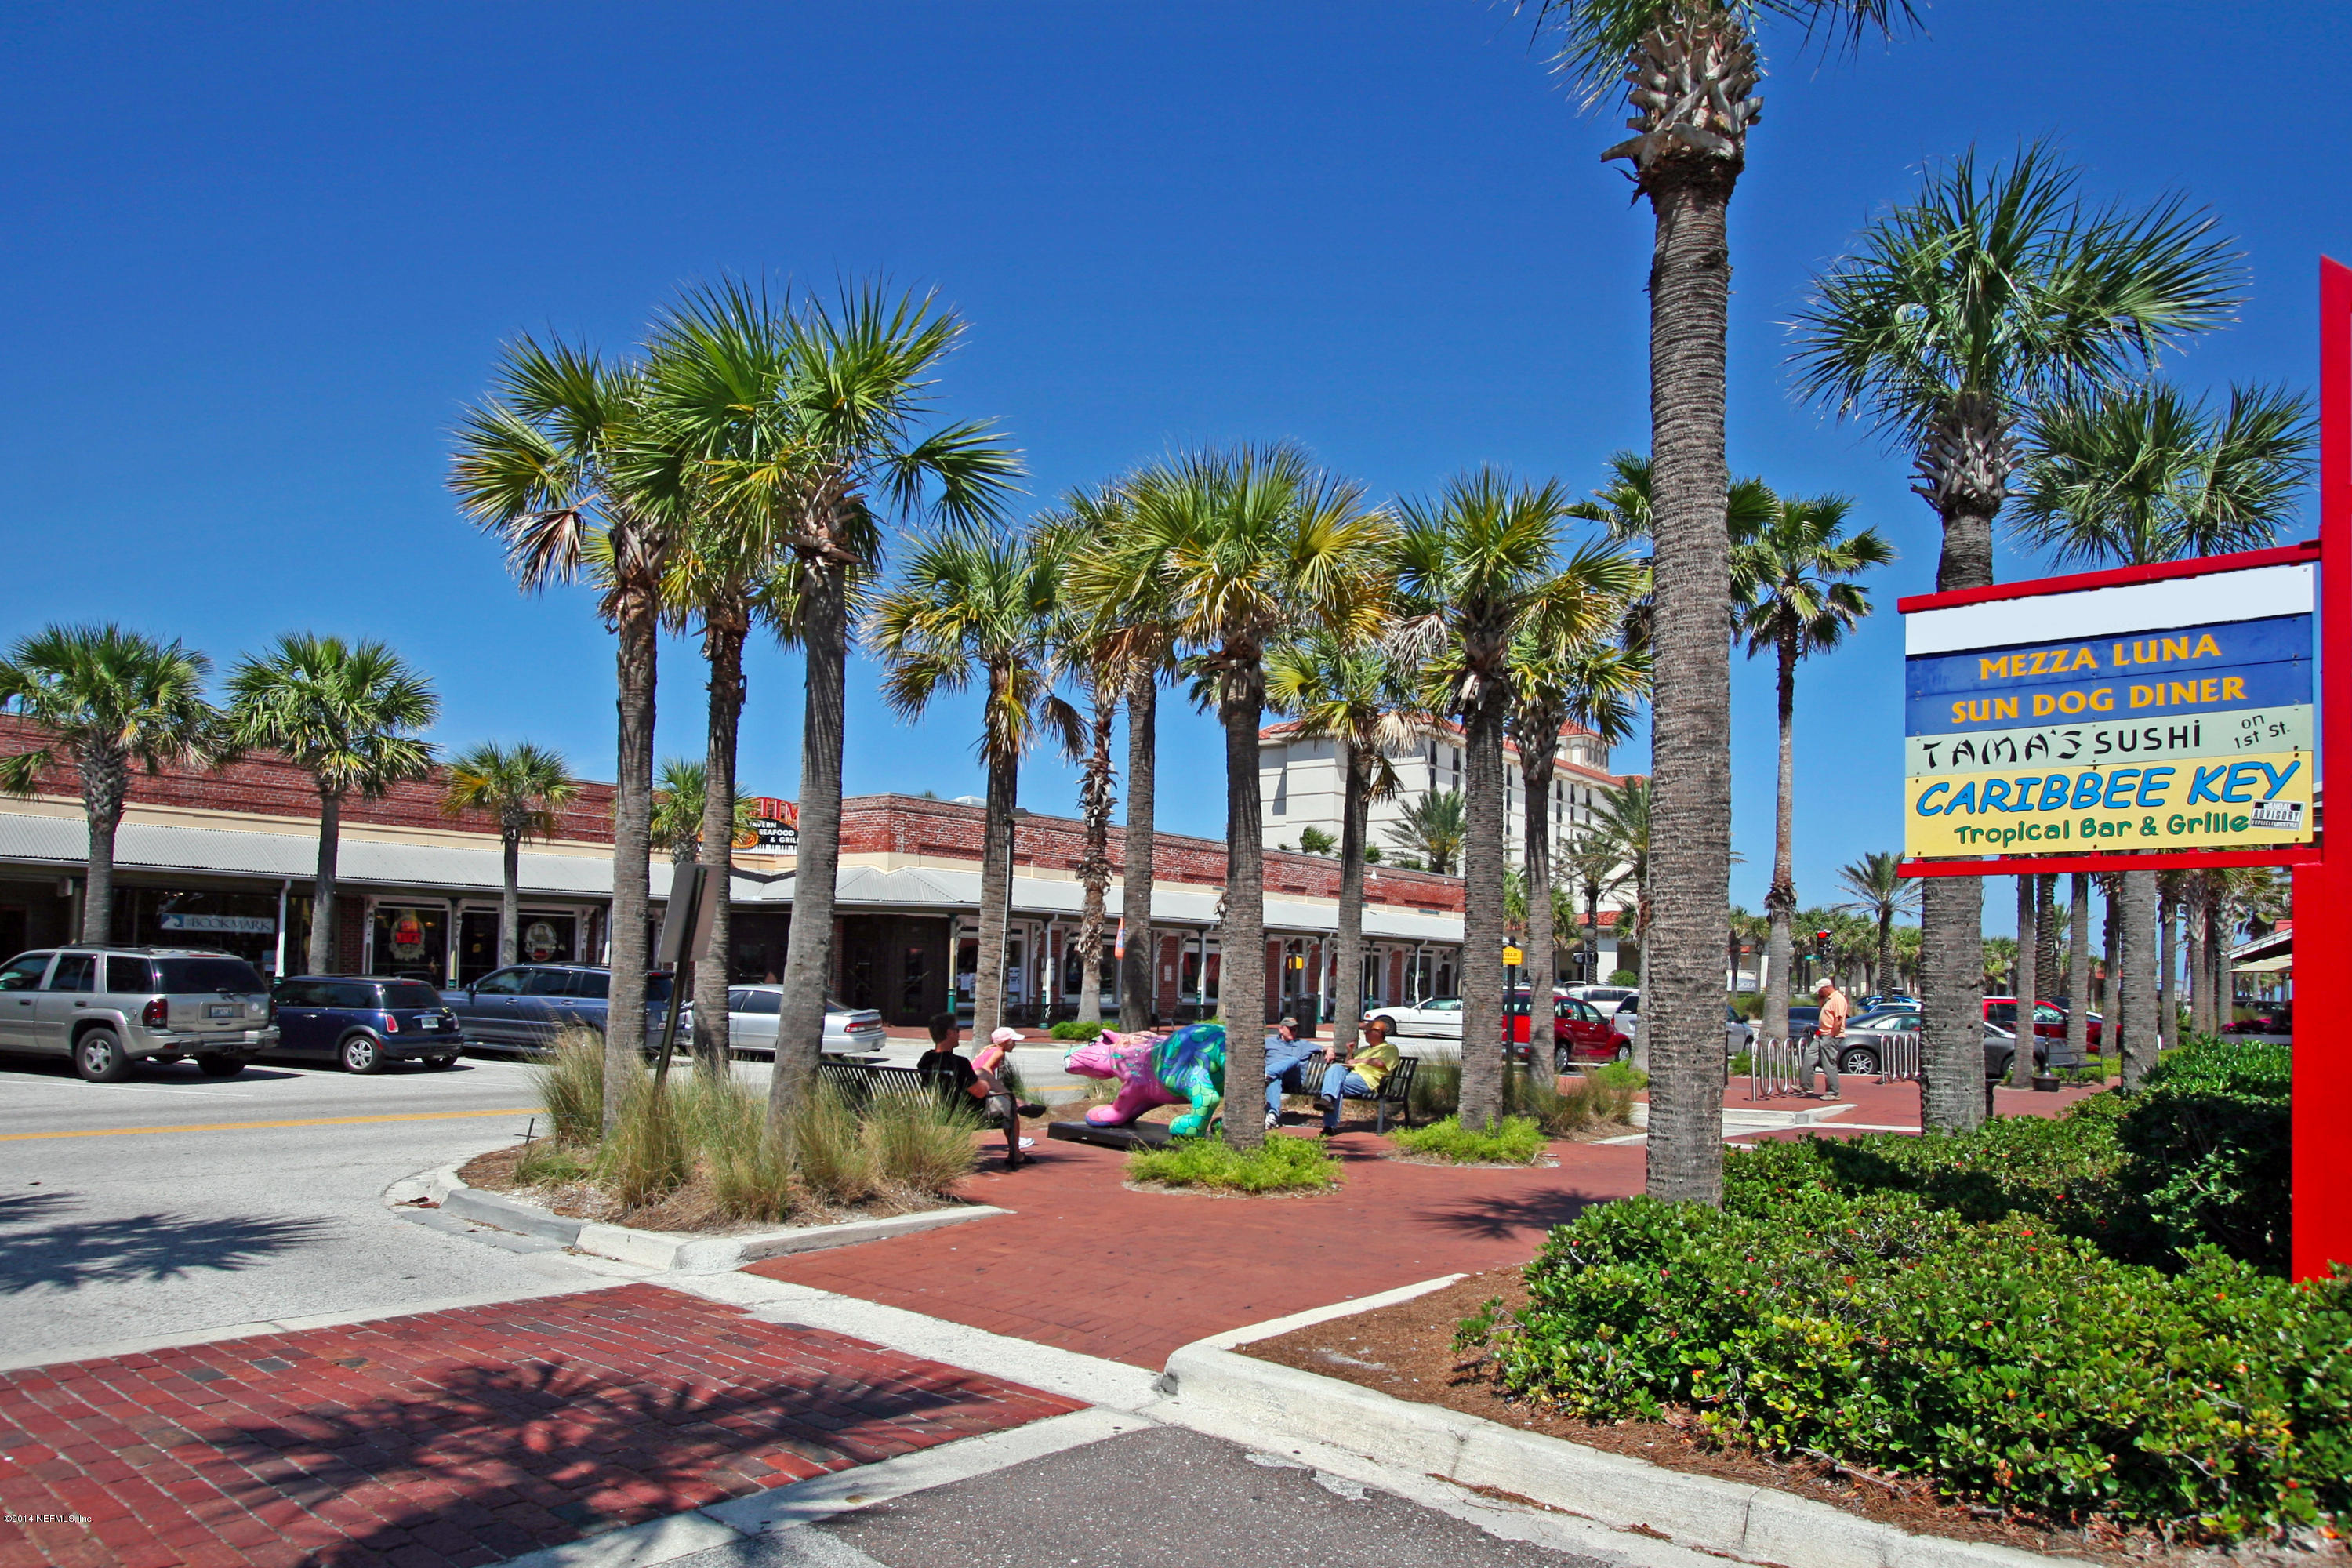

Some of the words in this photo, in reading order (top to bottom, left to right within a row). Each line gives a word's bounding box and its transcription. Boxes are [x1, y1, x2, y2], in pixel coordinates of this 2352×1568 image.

[1978, 647, 2099, 681] MEZZA
[2113, 633, 2222, 666] LUNA
[1951, 696, 2019, 724] SUN
[2033, 688, 2114, 717] DOG
[2129, 676, 2249, 709] DINER
[2234, 730, 2260, 749] 1st
[2268, 721, 2291, 738] St.
[2241, 714, 2265, 730] on
[1922, 728, 2082, 769] TAMA'S
[1916, 766, 2176, 817] CARIBBEE
[2187, 760, 2302, 806] KEY
[1954, 820, 2070, 848] Tropical
[2080, 817, 2132, 838] Bar
[2139, 815, 2159, 837] &
[2166, 811, 2249, 835] Grille
[2253, 809, 2300, 821] ADVISORY
[191, 916, 270, 931] BOOKMARK
